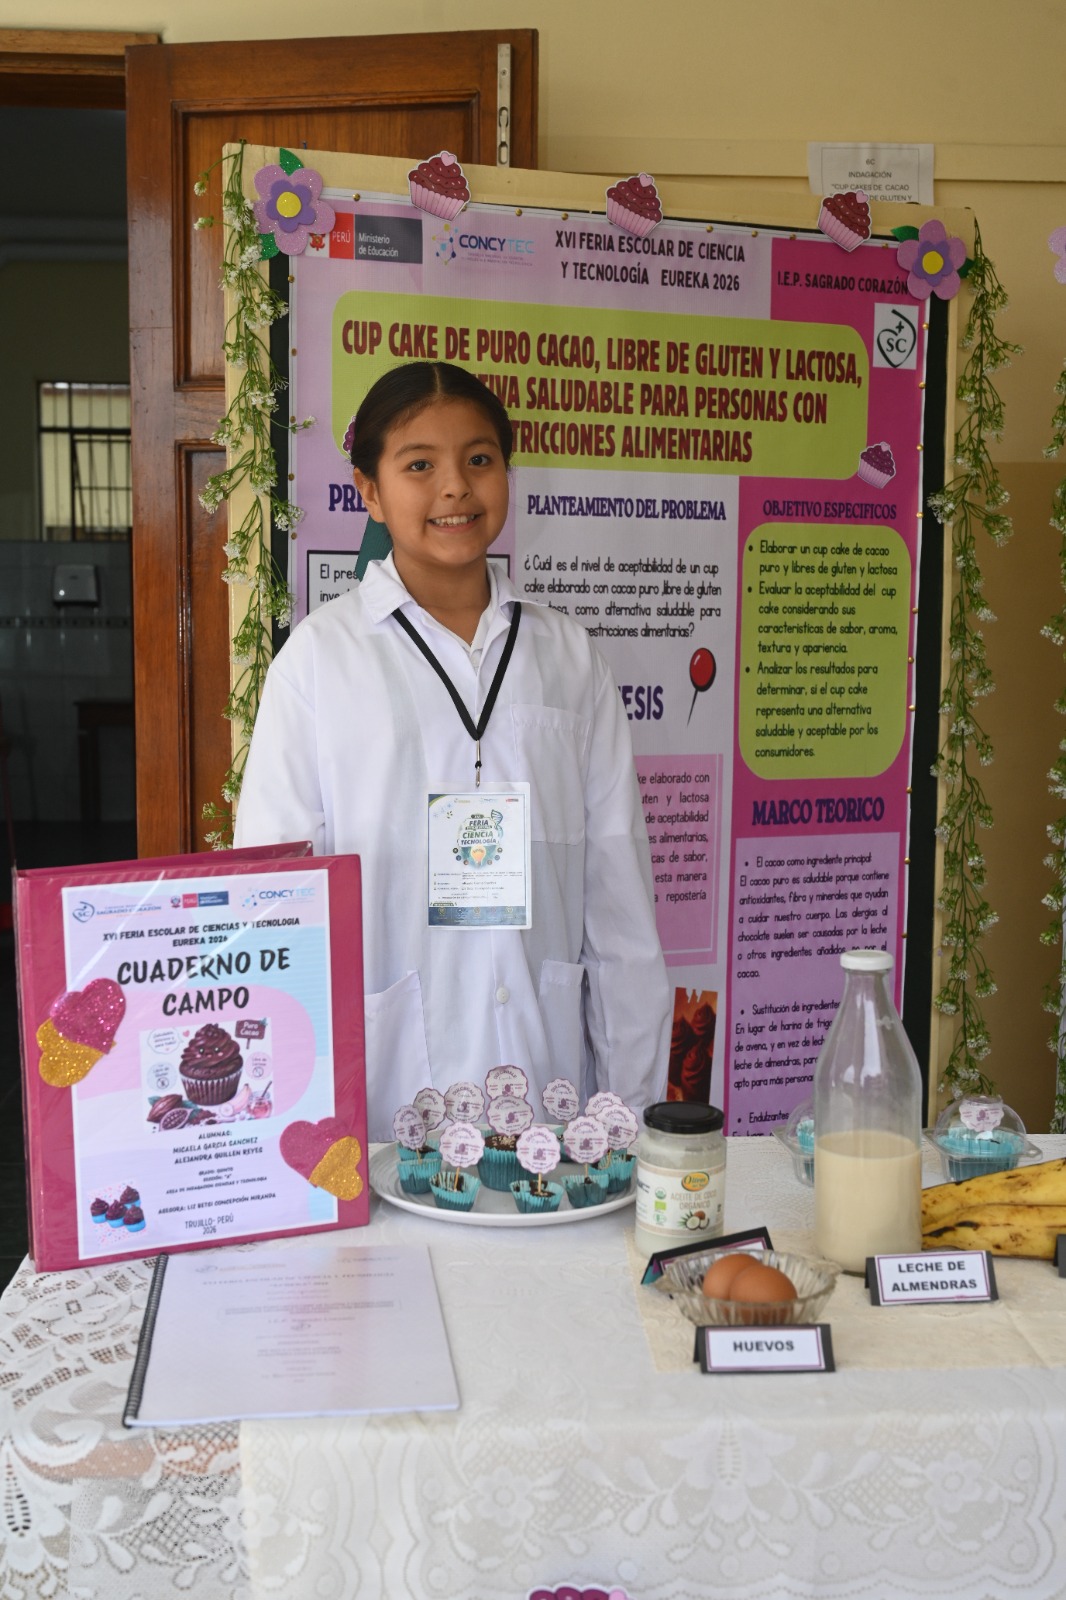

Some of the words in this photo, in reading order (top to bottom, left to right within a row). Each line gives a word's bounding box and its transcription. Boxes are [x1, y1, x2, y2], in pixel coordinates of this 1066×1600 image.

[333, 230, 350, 243] PERÚ
[359, 233, 390, 244] Ministerio
[359, 245, 366, 255] de
[368, 245, 398, 257] Educación
[459, 235, 535, 254] CONCYTEC
[555, 230, 576, 249] XVI
[579, 232, 615, 252] FERIA
[618, 235, 674, 257] ESCOLAR
[678, 240, 693, 258] DE
[698, 242, 745, 262] CIENCIA
[561, 261, 568, 279] Y
[573, 262, 649, 285] TECNOLOGÍA
[661, 269, 709, 289] EUREKA
[713, 273, 740, 291] 2026
[778, 271, 802, 287] I.E.P.
[805, 273, 855, 291] SAGRADO
[858, 276, 908, 295] CORAZÓN
[886, 338, 906, 353] SC
[342, 320, 382, 355] CUP
[389, 322, 438, 359] CAKE
[445, 326, 470, 361] DE
[477, 329, 531, 365] PURO
[536, 333, 600, 374] CACAO,
[607, 337, 660, 372] LIBRE
[667, 342, 689, 374] DE
[696, 343, 763, 378] GLUTEN
[770, 348, 780, 379] Y
[786, 349, 862, 388] LACTOSA,
[526, 376, 634, 414] SALUDABLE
[640, 383, 688, 417] PARA
[695, 386, 787, 422] PERSONAS
[793, 391, 827, 424] CON
[512, 420, 615, 457] TRICCIONES
[621, 425, 753, 463] ALIMENTARIAS
[527, 495, 634, 518] PLANTEAMIENTO
[636, 499, 660, 519] DEL
[661, 499, 726, 520] PROBLEMA
[763, 500, 821, 517] OBJETIVO
[824, 502, 896, 519] ESPECIFICOS
[760, 540, 797, 554] Elaborar
[801, 546, 810, 554] un
[813, 546, 827, 558] cup
[831, 543, 849, 555] cake
[853, 543, 862, 555] de
[865, 548, 890, 556] cacao
[557, 561, 567, 571] es
[570, 556, 578, 572] el
[581, 557, 600, 572] nivel
[604, 557, 615, 572] de
[618, 557, 672, 576] aceptabilidad
[675, 558, 686, 574] de
[690, 563, 700, 574] un
[703, 563, 719, 578] cup
[760, 564, 780, 576] puro
[783, 564, 788, 576] y
[792, 561, 815, 574] libres
[818, 562, 828, 574] de
[831, 562, 856, 577] gluten
[860, 565, 864, 577] y
[868, 562, 897, 575] lactosa
[524, 578, 545, 594] cake
[547, 578, 590, 594] elaborado
[593, 584, 608, 594] con
[611, 584, 636, 595] cacao
[639, 584, 659, 598] puro
[684, 581, 695, 595] de
[697, 580, 722, 599] gluten
[759, 581, 791, 595] Evaluar
[795, 582, 802, 595] la
[805, 582, 860, 598] aceptabilidad
[863, 584, 875, 596] del
[882, 587, 896, 599] cup
[575, 604, 599, 616] como
[605, 601, 651, 616] alternativa
[657, 602, 695, 617] saludable
[700, 605, 721, 621] para
[759, 601, 779, 615] cake
[782, 601, 839, 615] considerando
[842, 606, 856, 615] sus
[758, 641, 791, 653] textura
[795, 644, 800, 656] y
[803, 642, 848, 656] apariencia.
[757, 661, 793, 674] Analizar
[796, 661, 807, 674] los
[810, 662, 855, 675] resultados
[857, 666, 878, 677] para
[756, 703, 804, 719] representa
[808, 707, 822, 715] una
[825, 703, 871, 715] alternativa
[649, 772, 691, 784] elaborado
[695, 773, 709, 783] con
[679, 792, 709, 803] lactosa
[658, 811, 709, 826] aceptabilidad
[752, 799, 812, 825] MARCO
[815, 797, 885, 823] TEORICO
[462, 830, 494, 839] CIENCIA
[740, 875, 747, 887] El
[750, 876, 770, 886] cacao
[772, 875, 789, 887] puro
[792, 875, 800, 885] es
[802, 872, 833, 884] saludable
[836, 873, 859, 885] porque
[862, 870, 889, 881] contiene
[259, 888, 315, 899] CONCYTEC
[666, 889, 706, 904] repostería
[120, 930, 144, 939] FERIA
[148, 927, 185, 937] ESCOLAR
[203, 922, 239, 932] CIENCIAS
[738, 930, 770, 942] chocolate
[774, 928, 794, 940] suelen
[798, 930, 809, 939] ser
[813, 926, 843, 937] causadas
[846, 926, 858, 937] por
[862, 925, 867, 935] la
[871, 923, 887, 934] leche
[172, 937, 206, 947] EUREKA
[209, 935, 228, 944] 2026
[117, 951, 250, 985] CUADERNO
[260, 947, 291, 972] DE
[737, 969, 760, 979] cacao.
[162, 986, 250, 1016] CAMPO
[240, 1028, 259, 1036] Cacao
[243, 1021, 258, 1029] Puro
[749, 1110, 789, 1123] Endulzantes
[173, 1145, 201, 1153] MICAELA
[174, 1154, 212, 1164] ALEJANDRA
[214, 1196, 249, 1206] CONCEPCIÓN
[250, 1193, 276, 1201] MIRANDA
[203, 1225, 216, 1235] 2026
[897, 1260, 944, 1273] LECHE
[948, 1260, 966, 1272] DE
[891, 1278, 978, 1293] ALMENDRAS
[733, 1340, 795, 1352] HUEVOS
